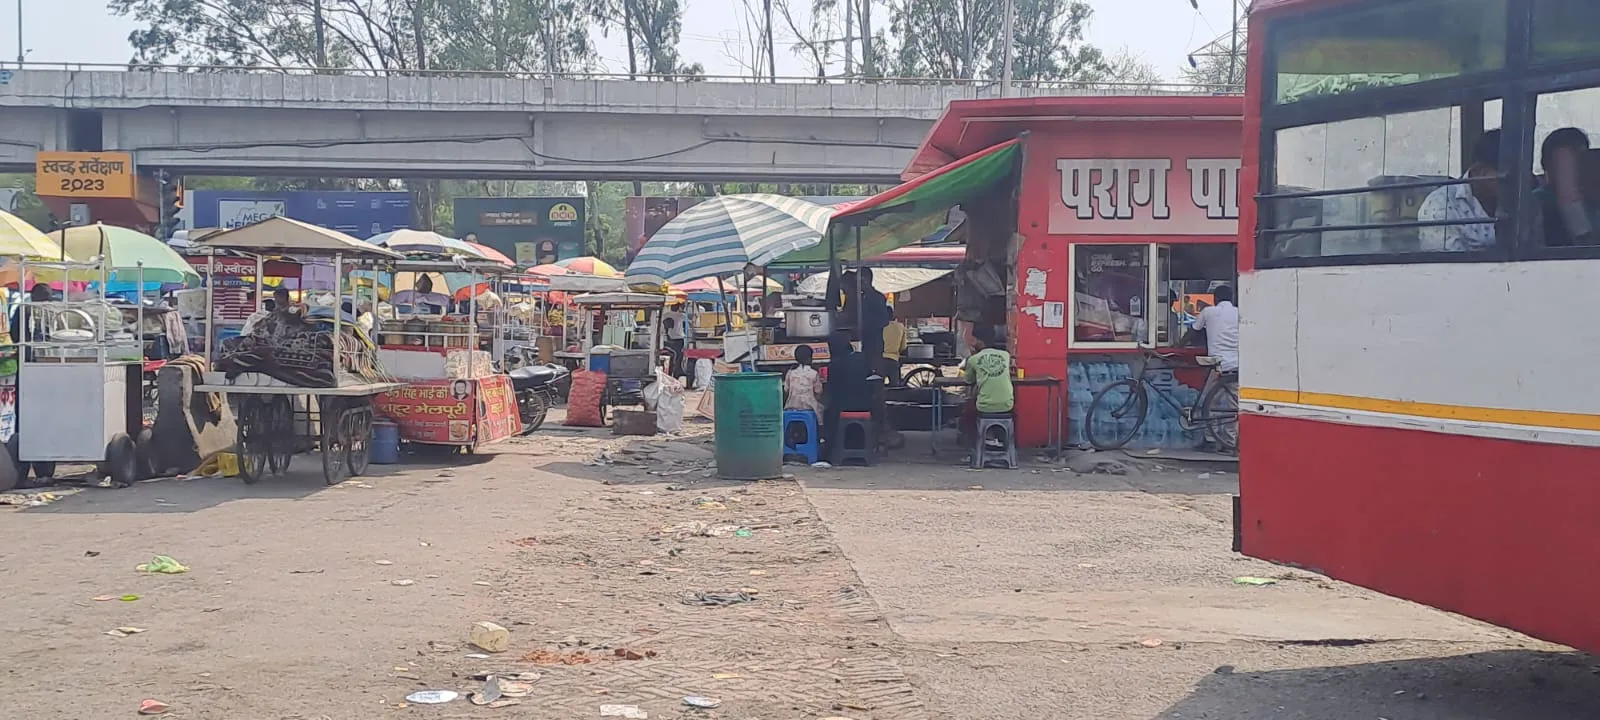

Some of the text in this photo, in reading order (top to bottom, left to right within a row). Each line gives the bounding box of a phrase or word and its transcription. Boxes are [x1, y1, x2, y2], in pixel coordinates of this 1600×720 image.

[42, 157, 125, 176] स्वच्छ सर्वेक्षण
[60, 178, 105, 192] 2023
[1056, 158, 1172, 220] पराग
